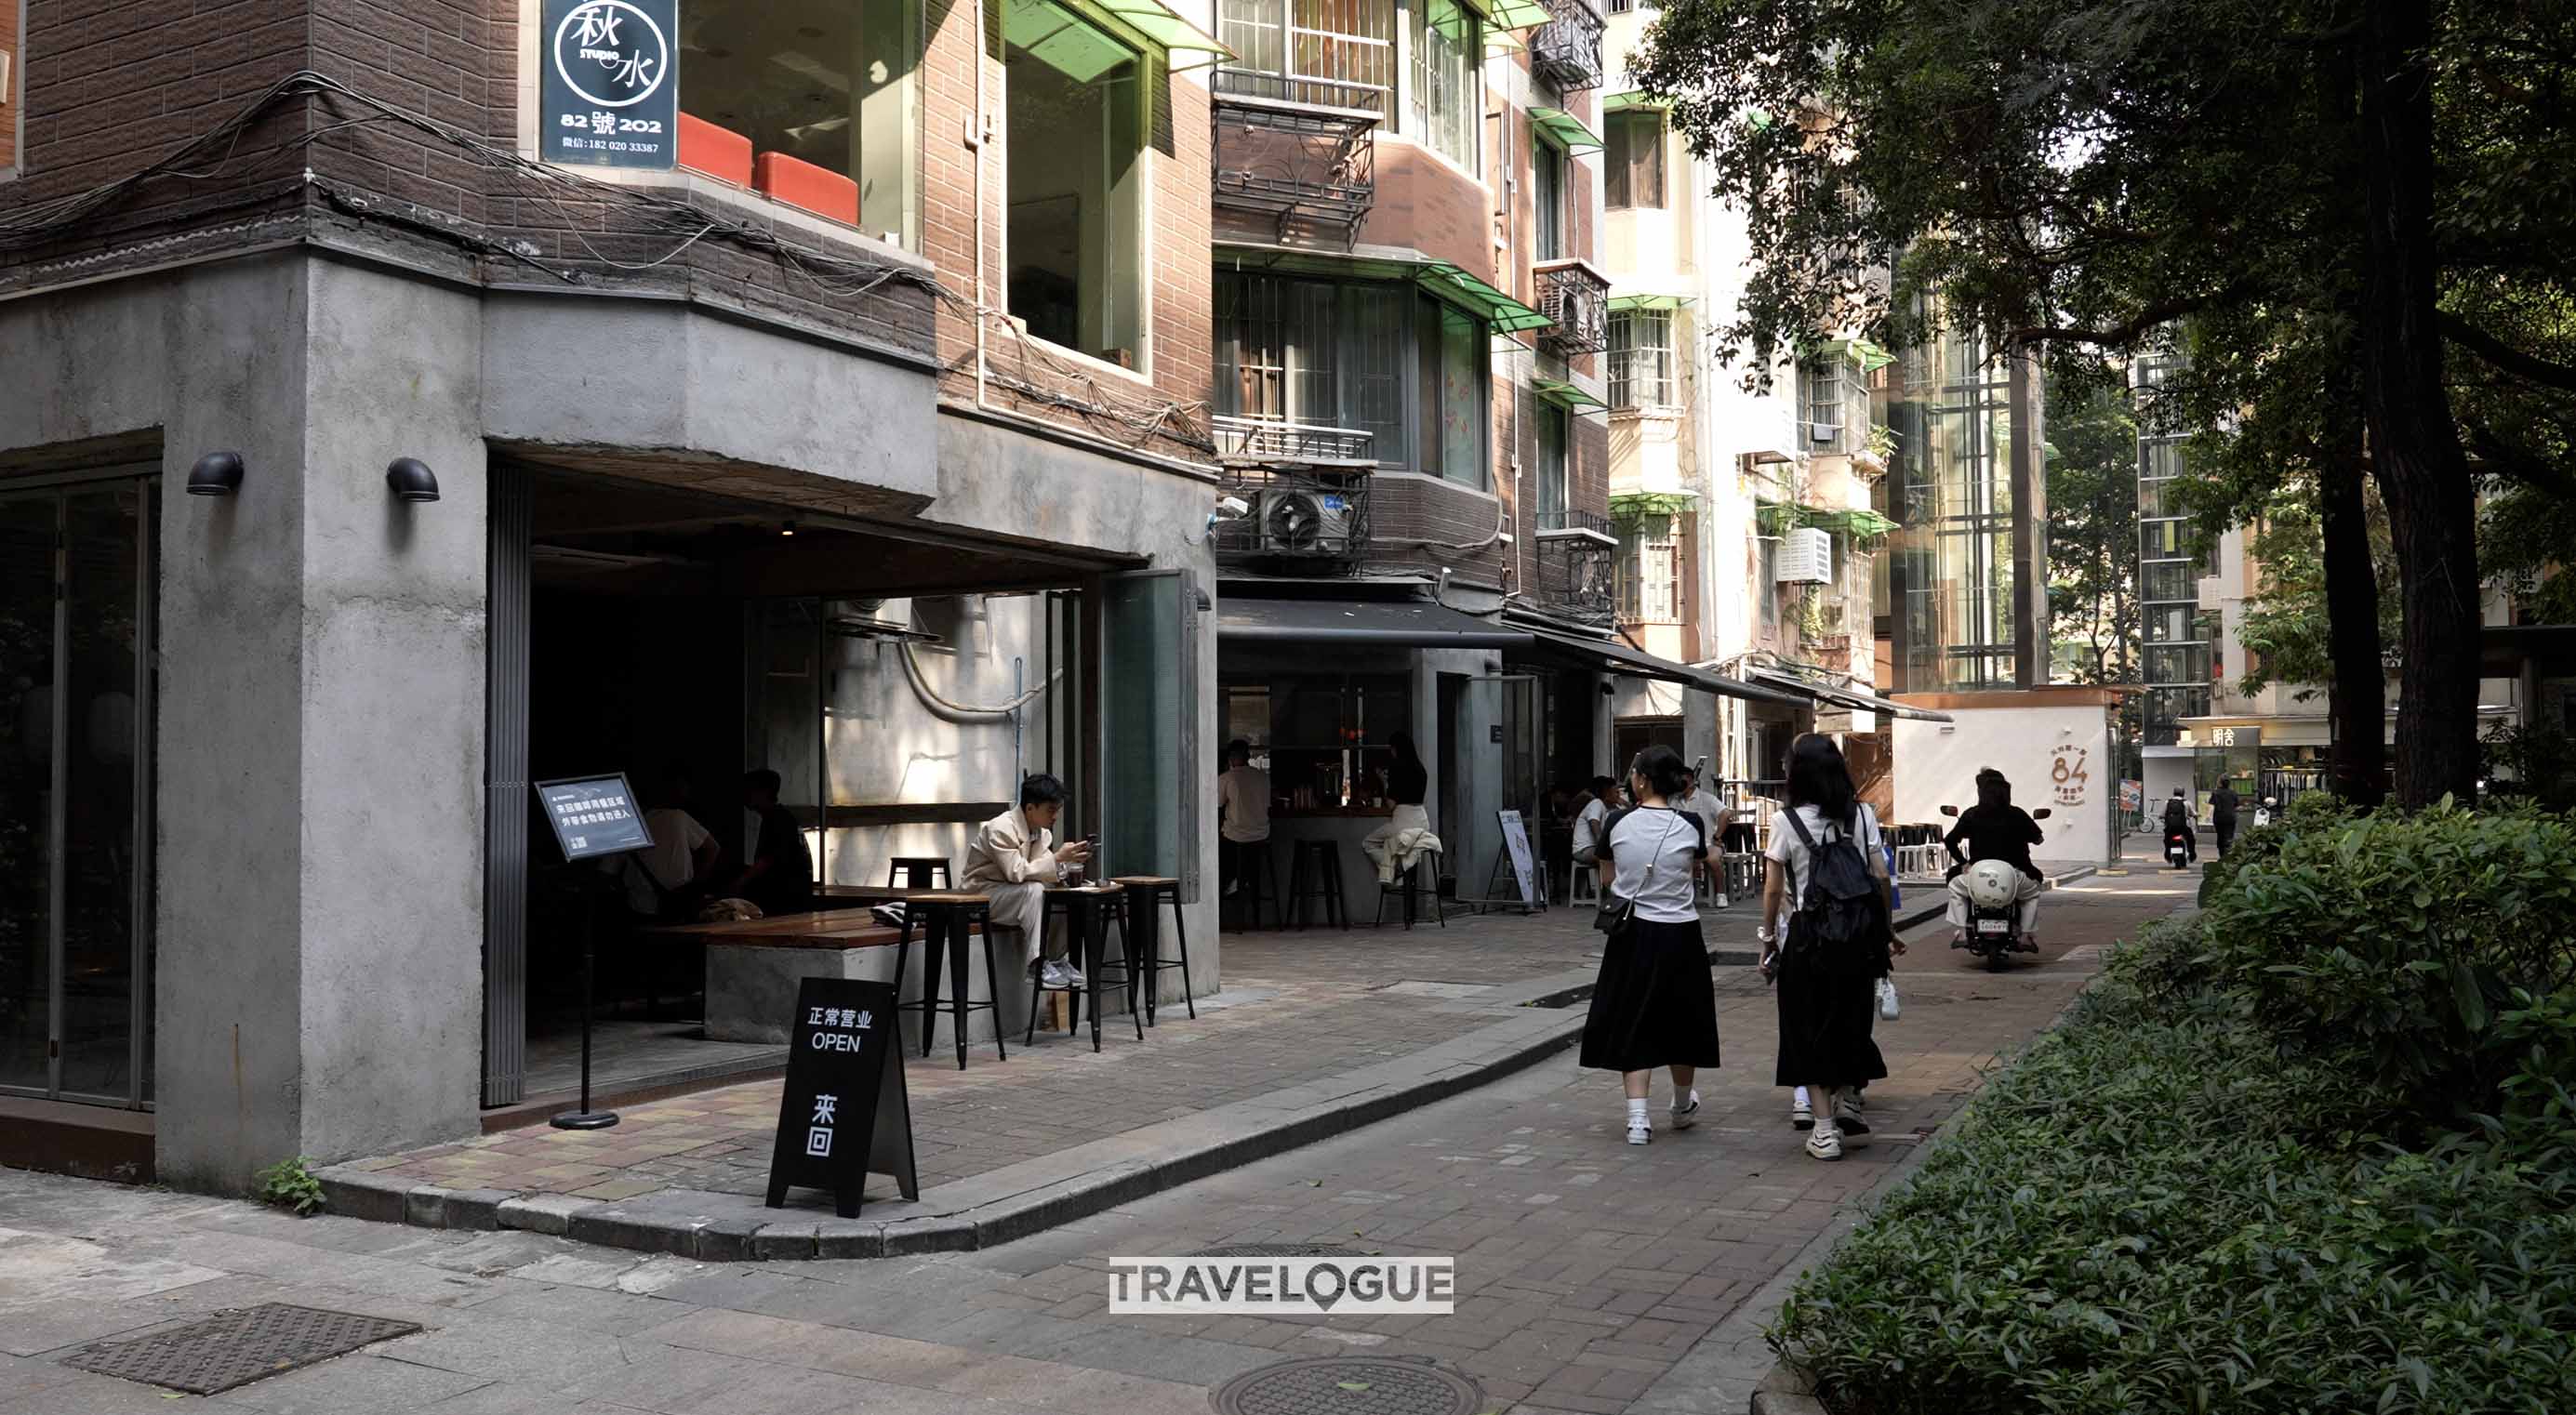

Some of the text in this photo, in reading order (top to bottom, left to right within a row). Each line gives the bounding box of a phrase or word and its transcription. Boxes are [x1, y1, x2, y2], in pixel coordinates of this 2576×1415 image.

[570, 6, 624, 46] 秋
[579, 48, 619, 60] STUDIO
[611, 49, 654, 87] 水
[560, 111, 662, 135] 82 號 202
[608, 140, 627, 151] 020
[629, 142, 658, 153] 33387
[2052, 757, 2088, 784] 84
[808, 1007, 872, 1029] 正常营业
[812, 1032, 861, 1052] OPEN
[806, 1094, 838, 1157] 来回
